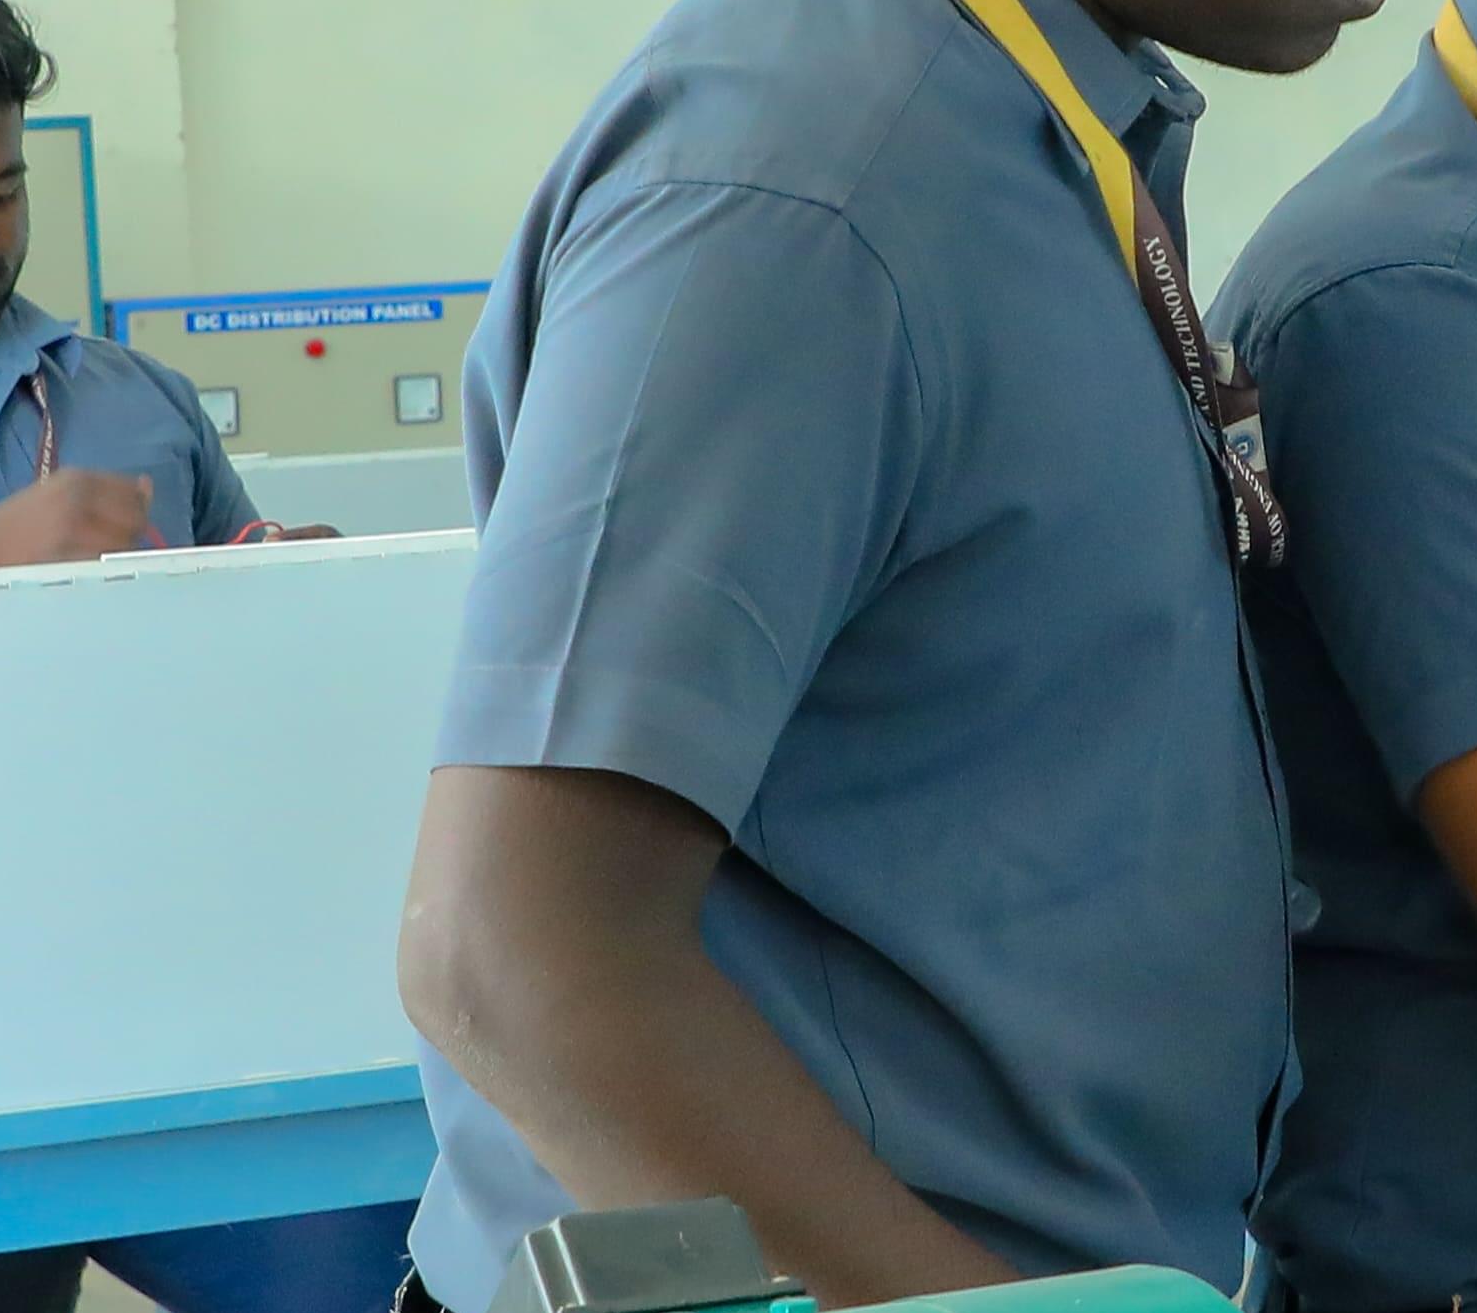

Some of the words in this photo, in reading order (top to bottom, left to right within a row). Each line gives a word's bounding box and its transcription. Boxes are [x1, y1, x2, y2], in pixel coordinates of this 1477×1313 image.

[194, 314, 222, 330] DC
[227, 305, 368, 328] DISTRIBUTION
[373, 301, 434, 320] PANEL
[1143, 236, 1202, 373] TECHNOLOGY
[1267, 513, 1283, 536] OF
